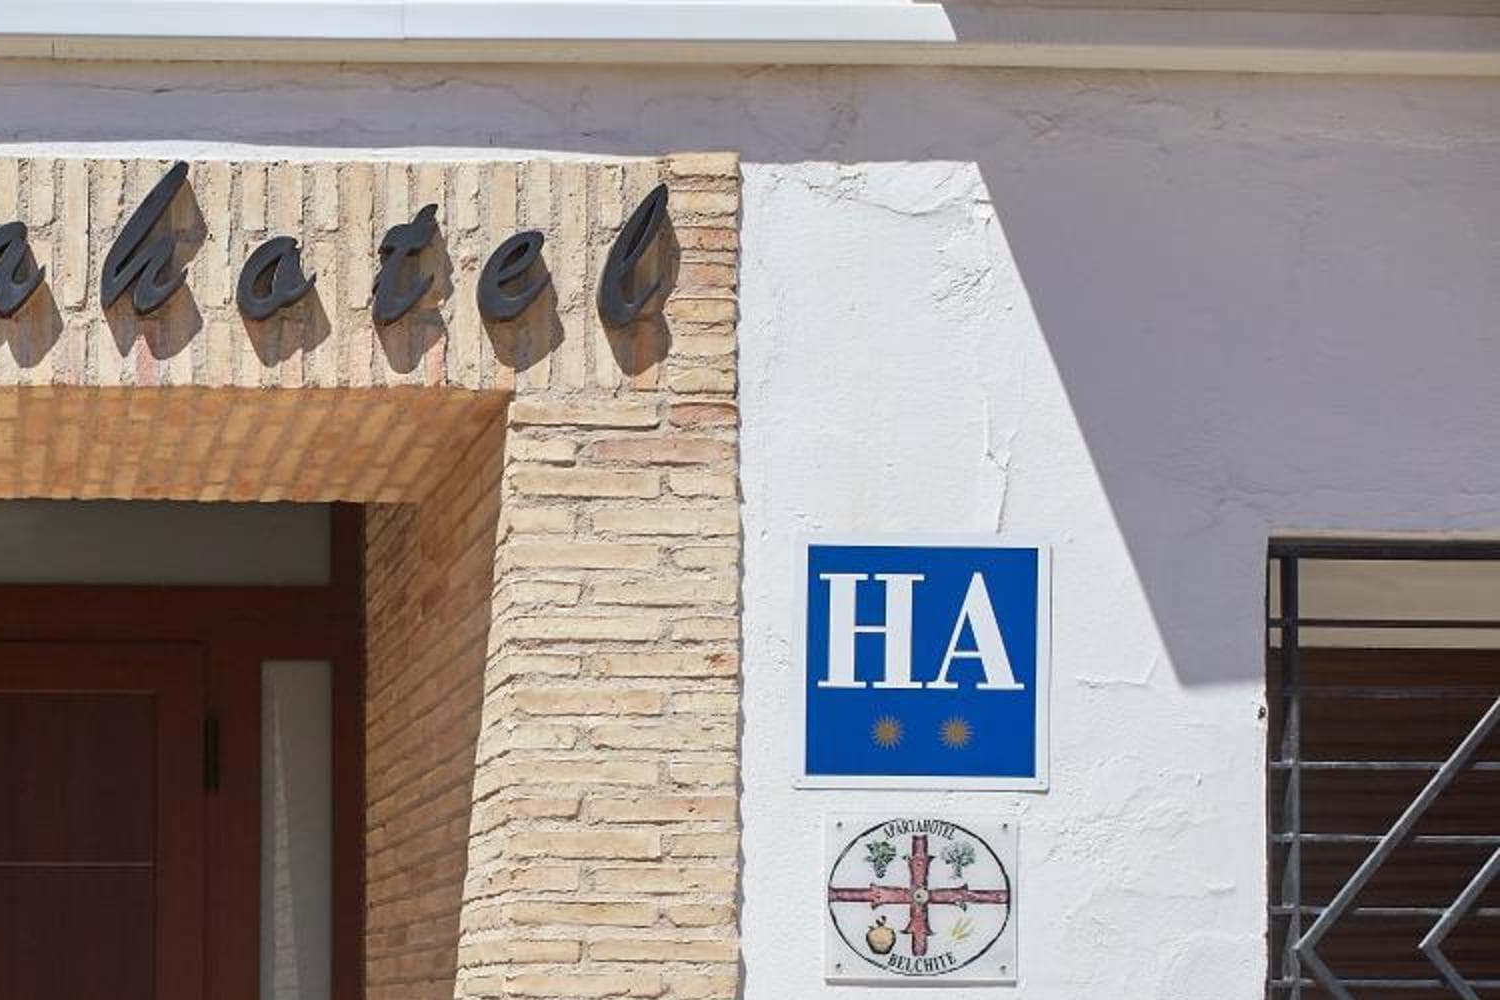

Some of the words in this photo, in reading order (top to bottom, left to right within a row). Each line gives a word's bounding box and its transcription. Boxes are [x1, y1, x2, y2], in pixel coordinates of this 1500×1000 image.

[818, 572, 1025, 690] HA
[884, 818, 956, 841] APARTAHOTEL
[887, 952, 957, 973] BELCHITE
